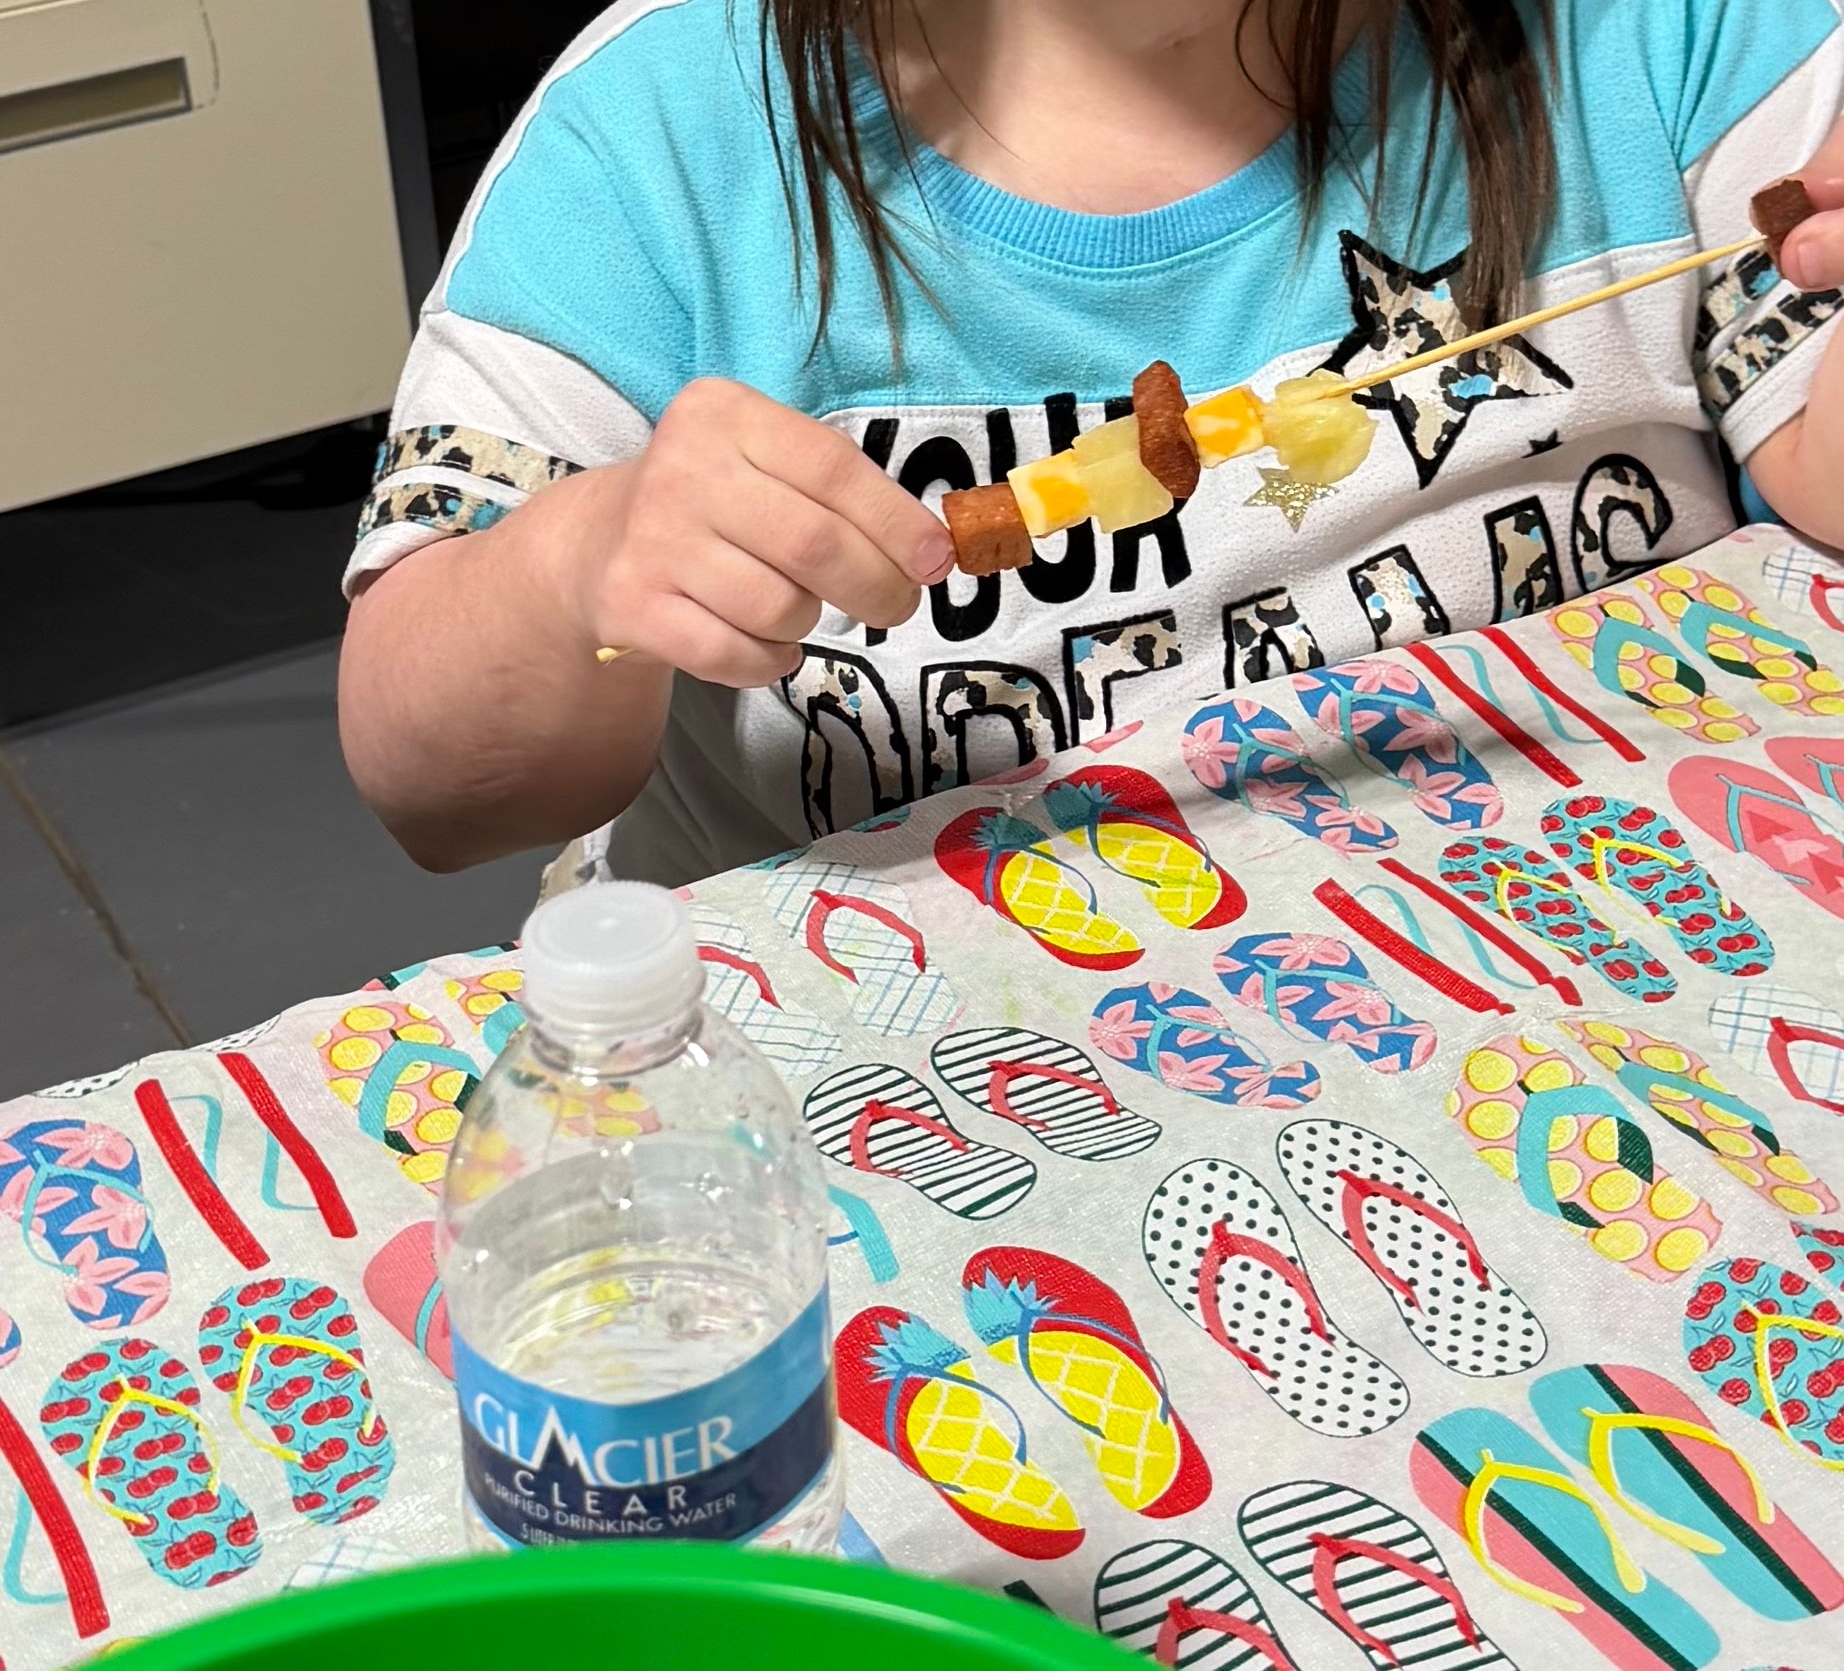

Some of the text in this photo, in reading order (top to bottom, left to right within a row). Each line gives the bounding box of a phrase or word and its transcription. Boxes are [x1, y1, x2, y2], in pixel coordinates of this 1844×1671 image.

[474, 1392, 739, 1489] GLACIER
[484, 1471, 737, 1533] PURIFIED DRINKING WATER
[514, 1469, 688, 1516] CLEAR
